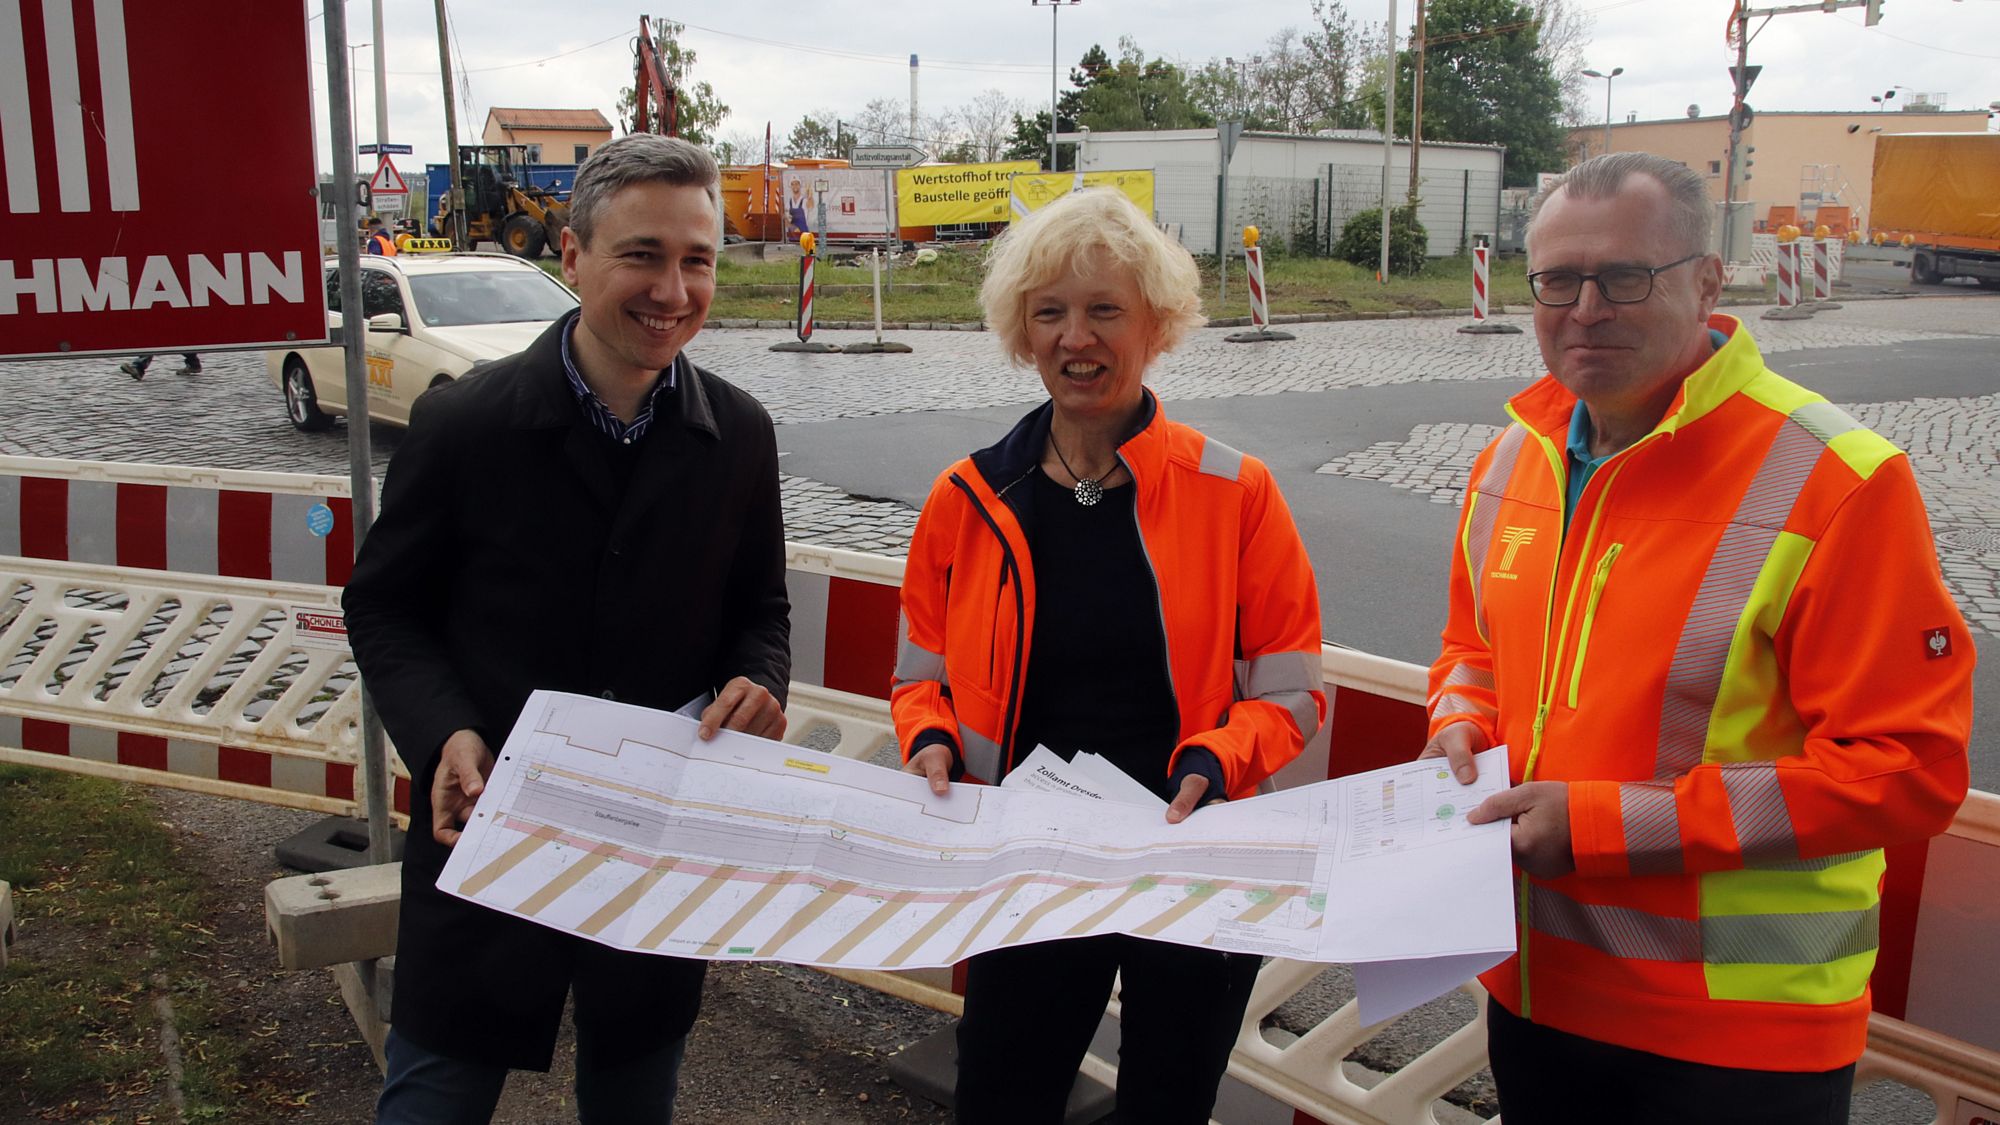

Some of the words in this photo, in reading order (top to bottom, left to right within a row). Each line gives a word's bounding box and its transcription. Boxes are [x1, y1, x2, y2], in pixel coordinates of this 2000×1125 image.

[855, 152, 912, 163] Justizvollzugsanstalt
[913, 170, 992, 185] Wertstoffhof
[914, 190, 970, 203] Baustelle
[416, 239, 447, 249] TAXI
[1037, 765, 1071, 788] Zollamt
[1070, 784, 1103, 800] Dresde
